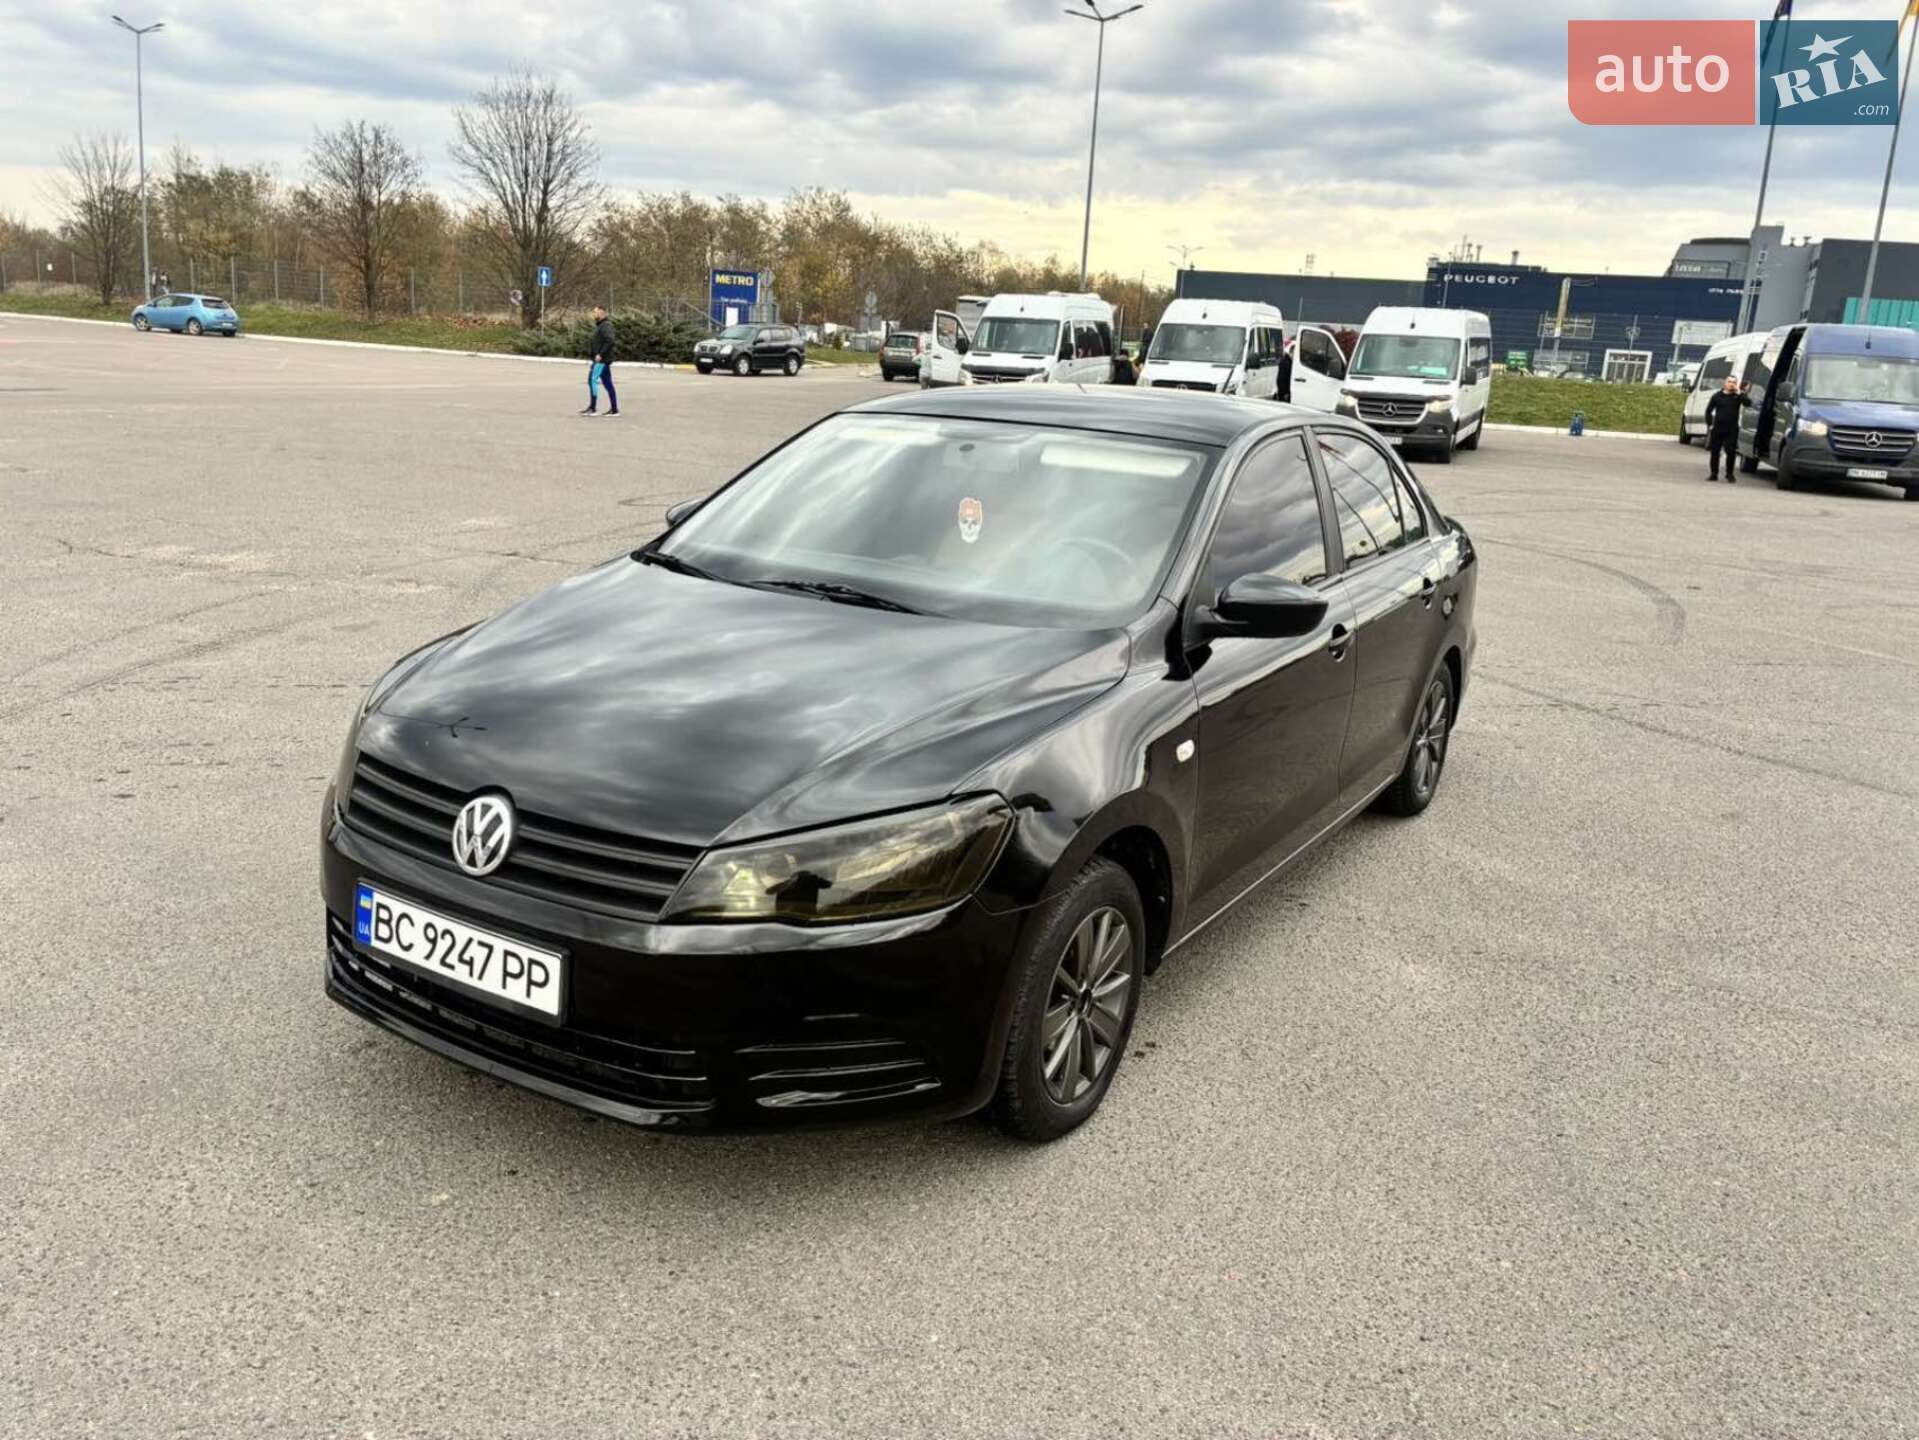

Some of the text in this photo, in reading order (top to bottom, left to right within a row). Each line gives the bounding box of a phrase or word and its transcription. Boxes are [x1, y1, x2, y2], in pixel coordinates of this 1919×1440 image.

[715, 274, 754, 286] METRO
[1444, 273, 1520, 285] PEUGEOT
[359, 920, 370, 936] UA
[374, 902, 550, 999] BC 9247 PP
